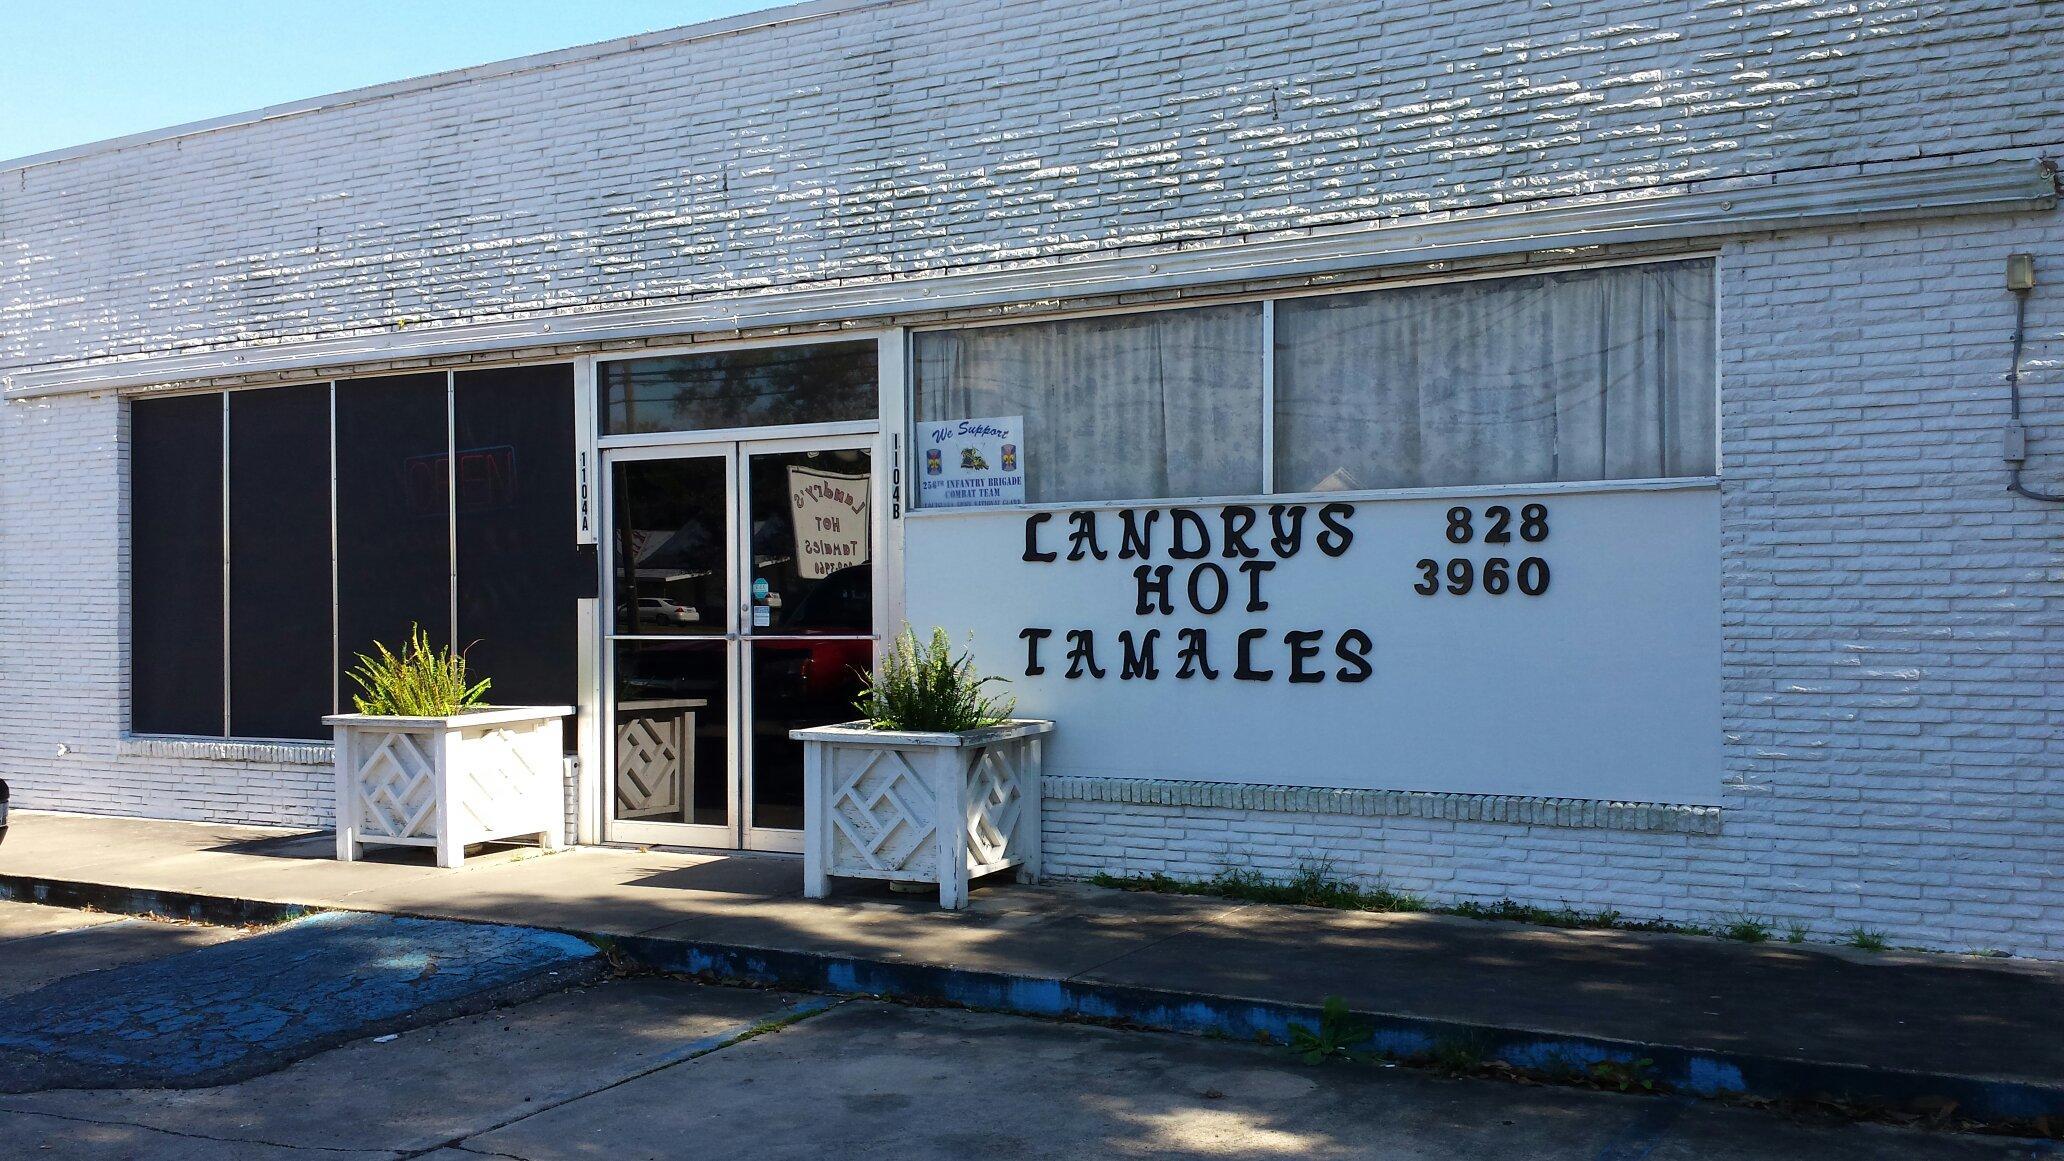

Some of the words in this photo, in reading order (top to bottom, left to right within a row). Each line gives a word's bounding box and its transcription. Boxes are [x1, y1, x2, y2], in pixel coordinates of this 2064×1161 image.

[932, 427, 954, 444] We
[958, 421, 1009, 439] Support
[945, 489, 977, 499] COMBAT
[979, 488, 1000, 498] TEAM
[946, 478, 985, 489] INFANTRY
[988, 476, 1022, 487] BRIGADE
[1022, 502, 1356, 562] LANDRYS
[1445, 503, 1550, 546] 828
[1132, 560, 1277, 616] HOT
[1413, 556, 1551, 597] 3960
[1018, 627, 1373, 684] TAMALES
